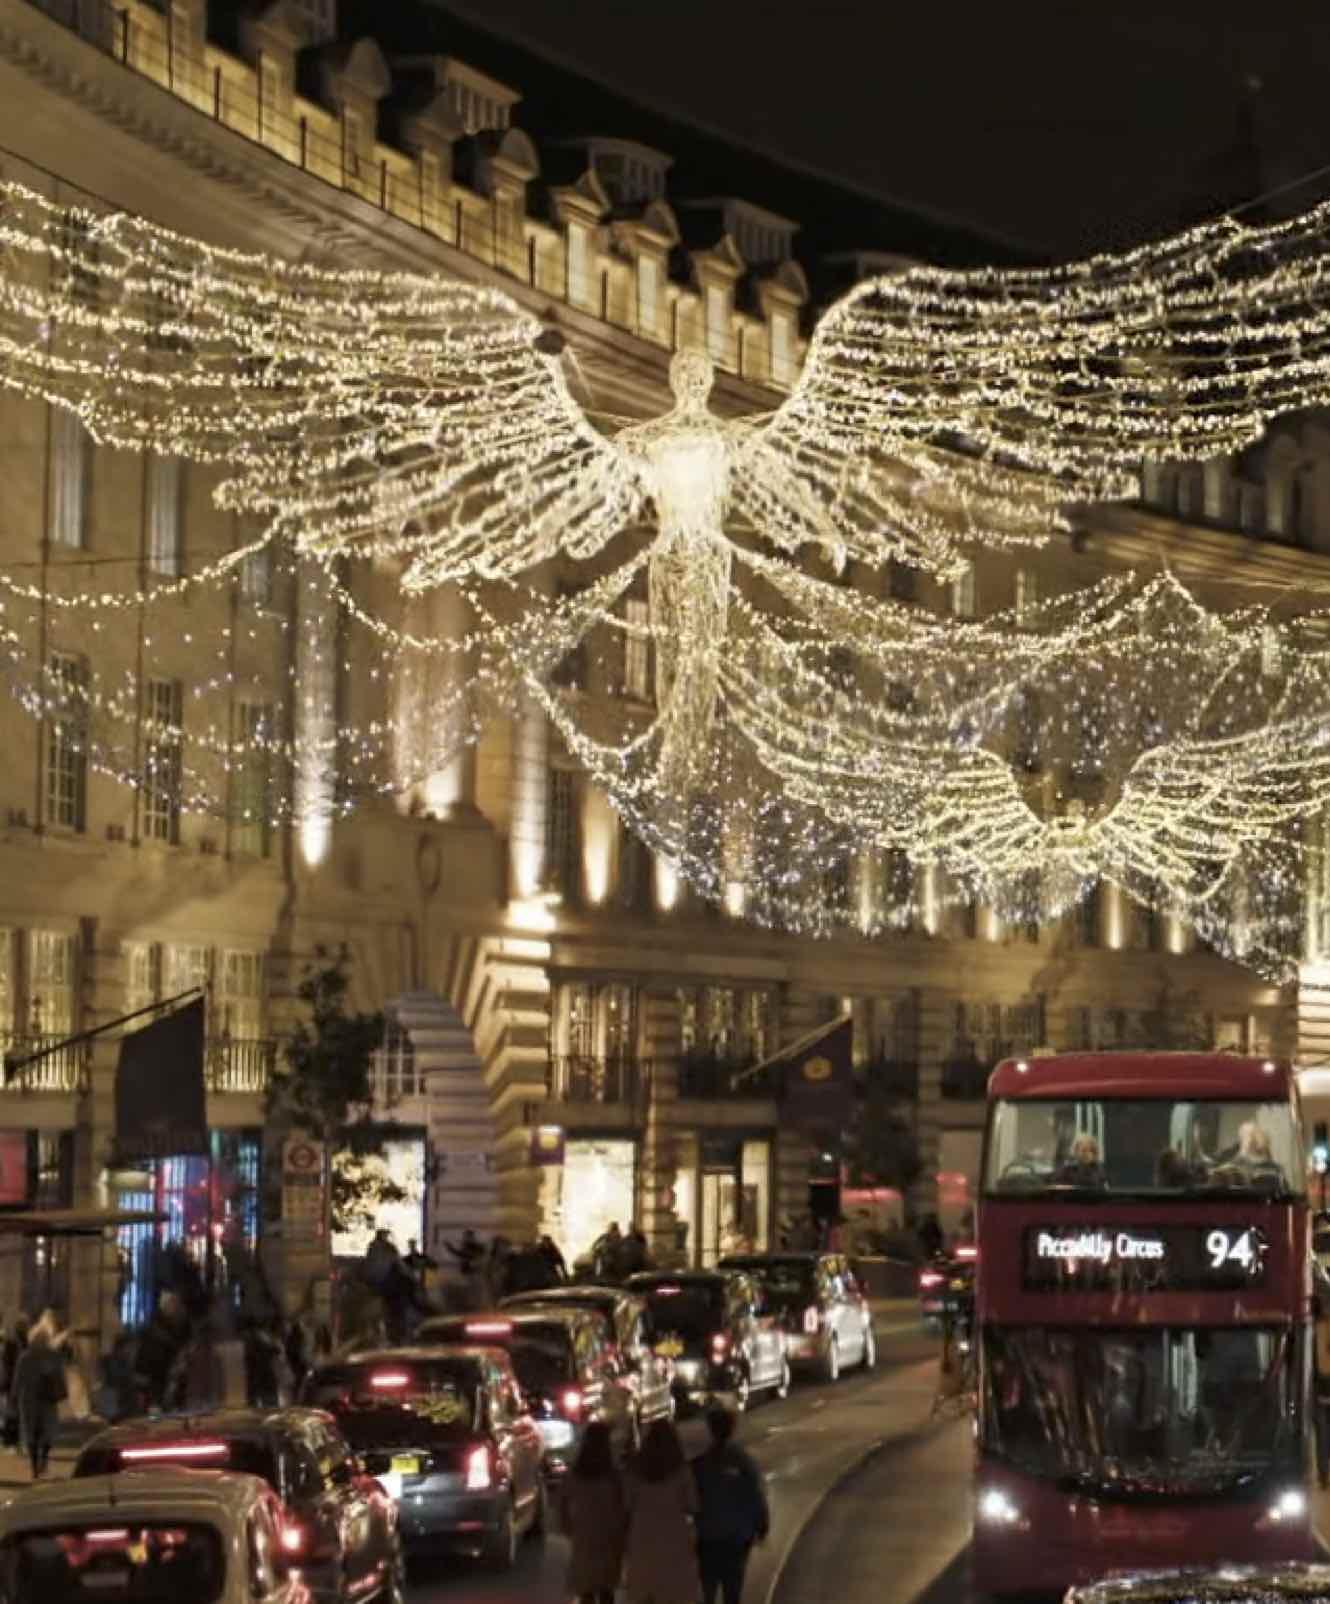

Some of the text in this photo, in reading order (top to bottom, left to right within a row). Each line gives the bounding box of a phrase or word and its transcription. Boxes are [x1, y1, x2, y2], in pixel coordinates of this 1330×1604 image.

[1037, 1230, 1253, 1267] Piccadilly Circus 94
